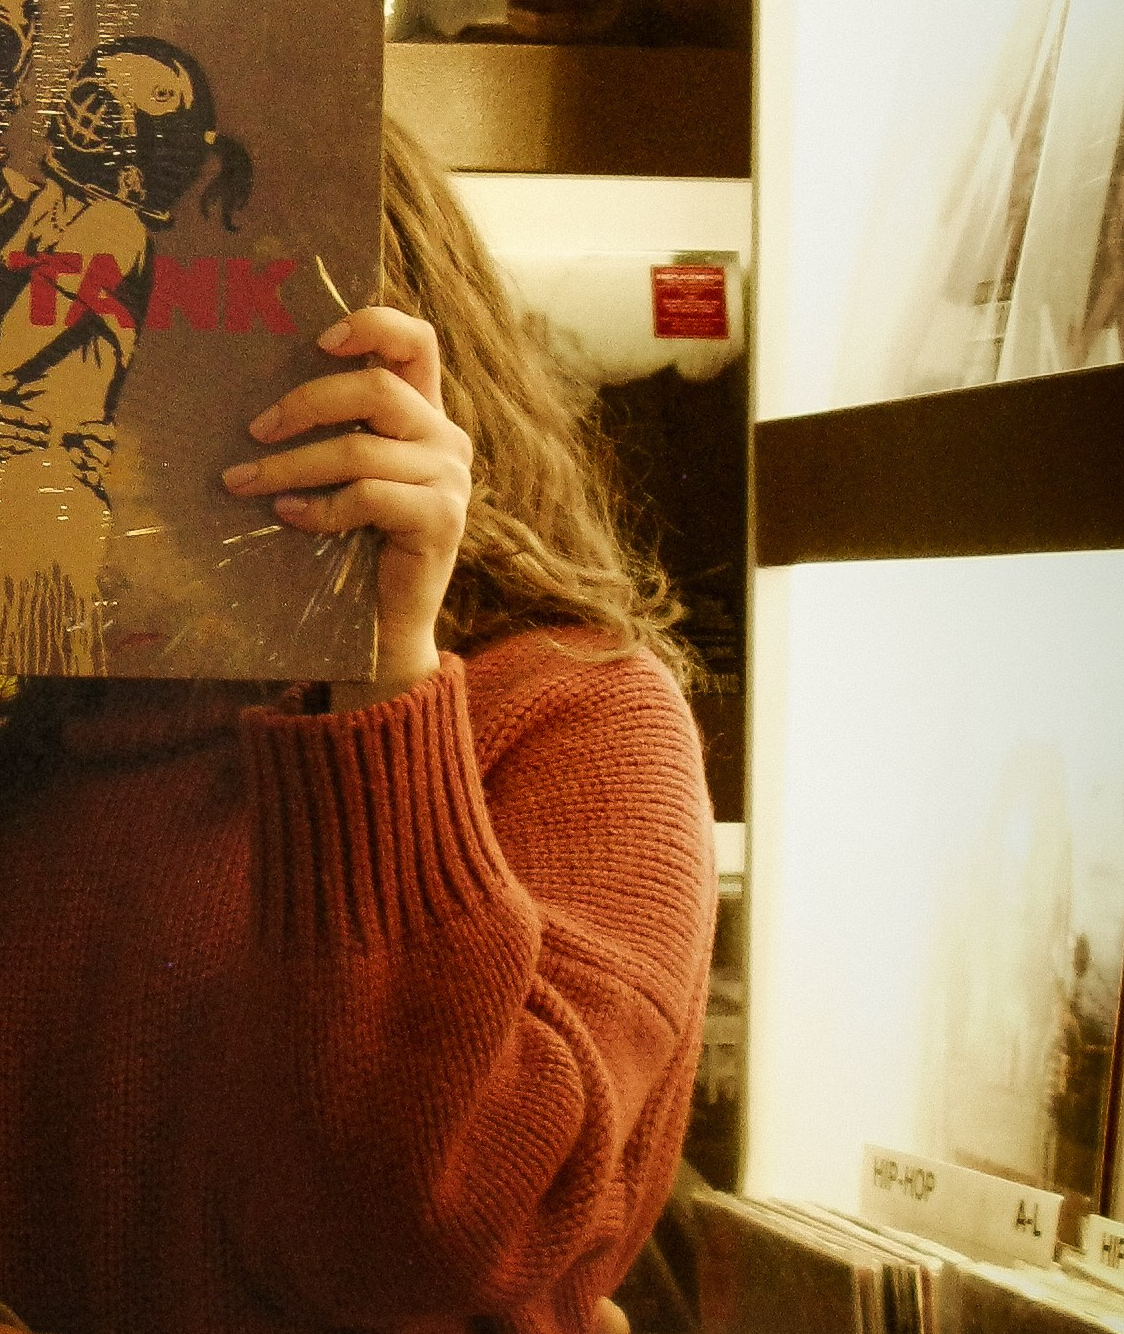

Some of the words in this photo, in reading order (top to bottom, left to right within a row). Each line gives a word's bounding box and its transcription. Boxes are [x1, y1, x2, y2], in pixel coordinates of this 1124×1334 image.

[8, 250, 299, 337] TANK
[873, 1155, 936, 1201] HIP-HOP
[1013, 1198, 1043, 1238] A-L
